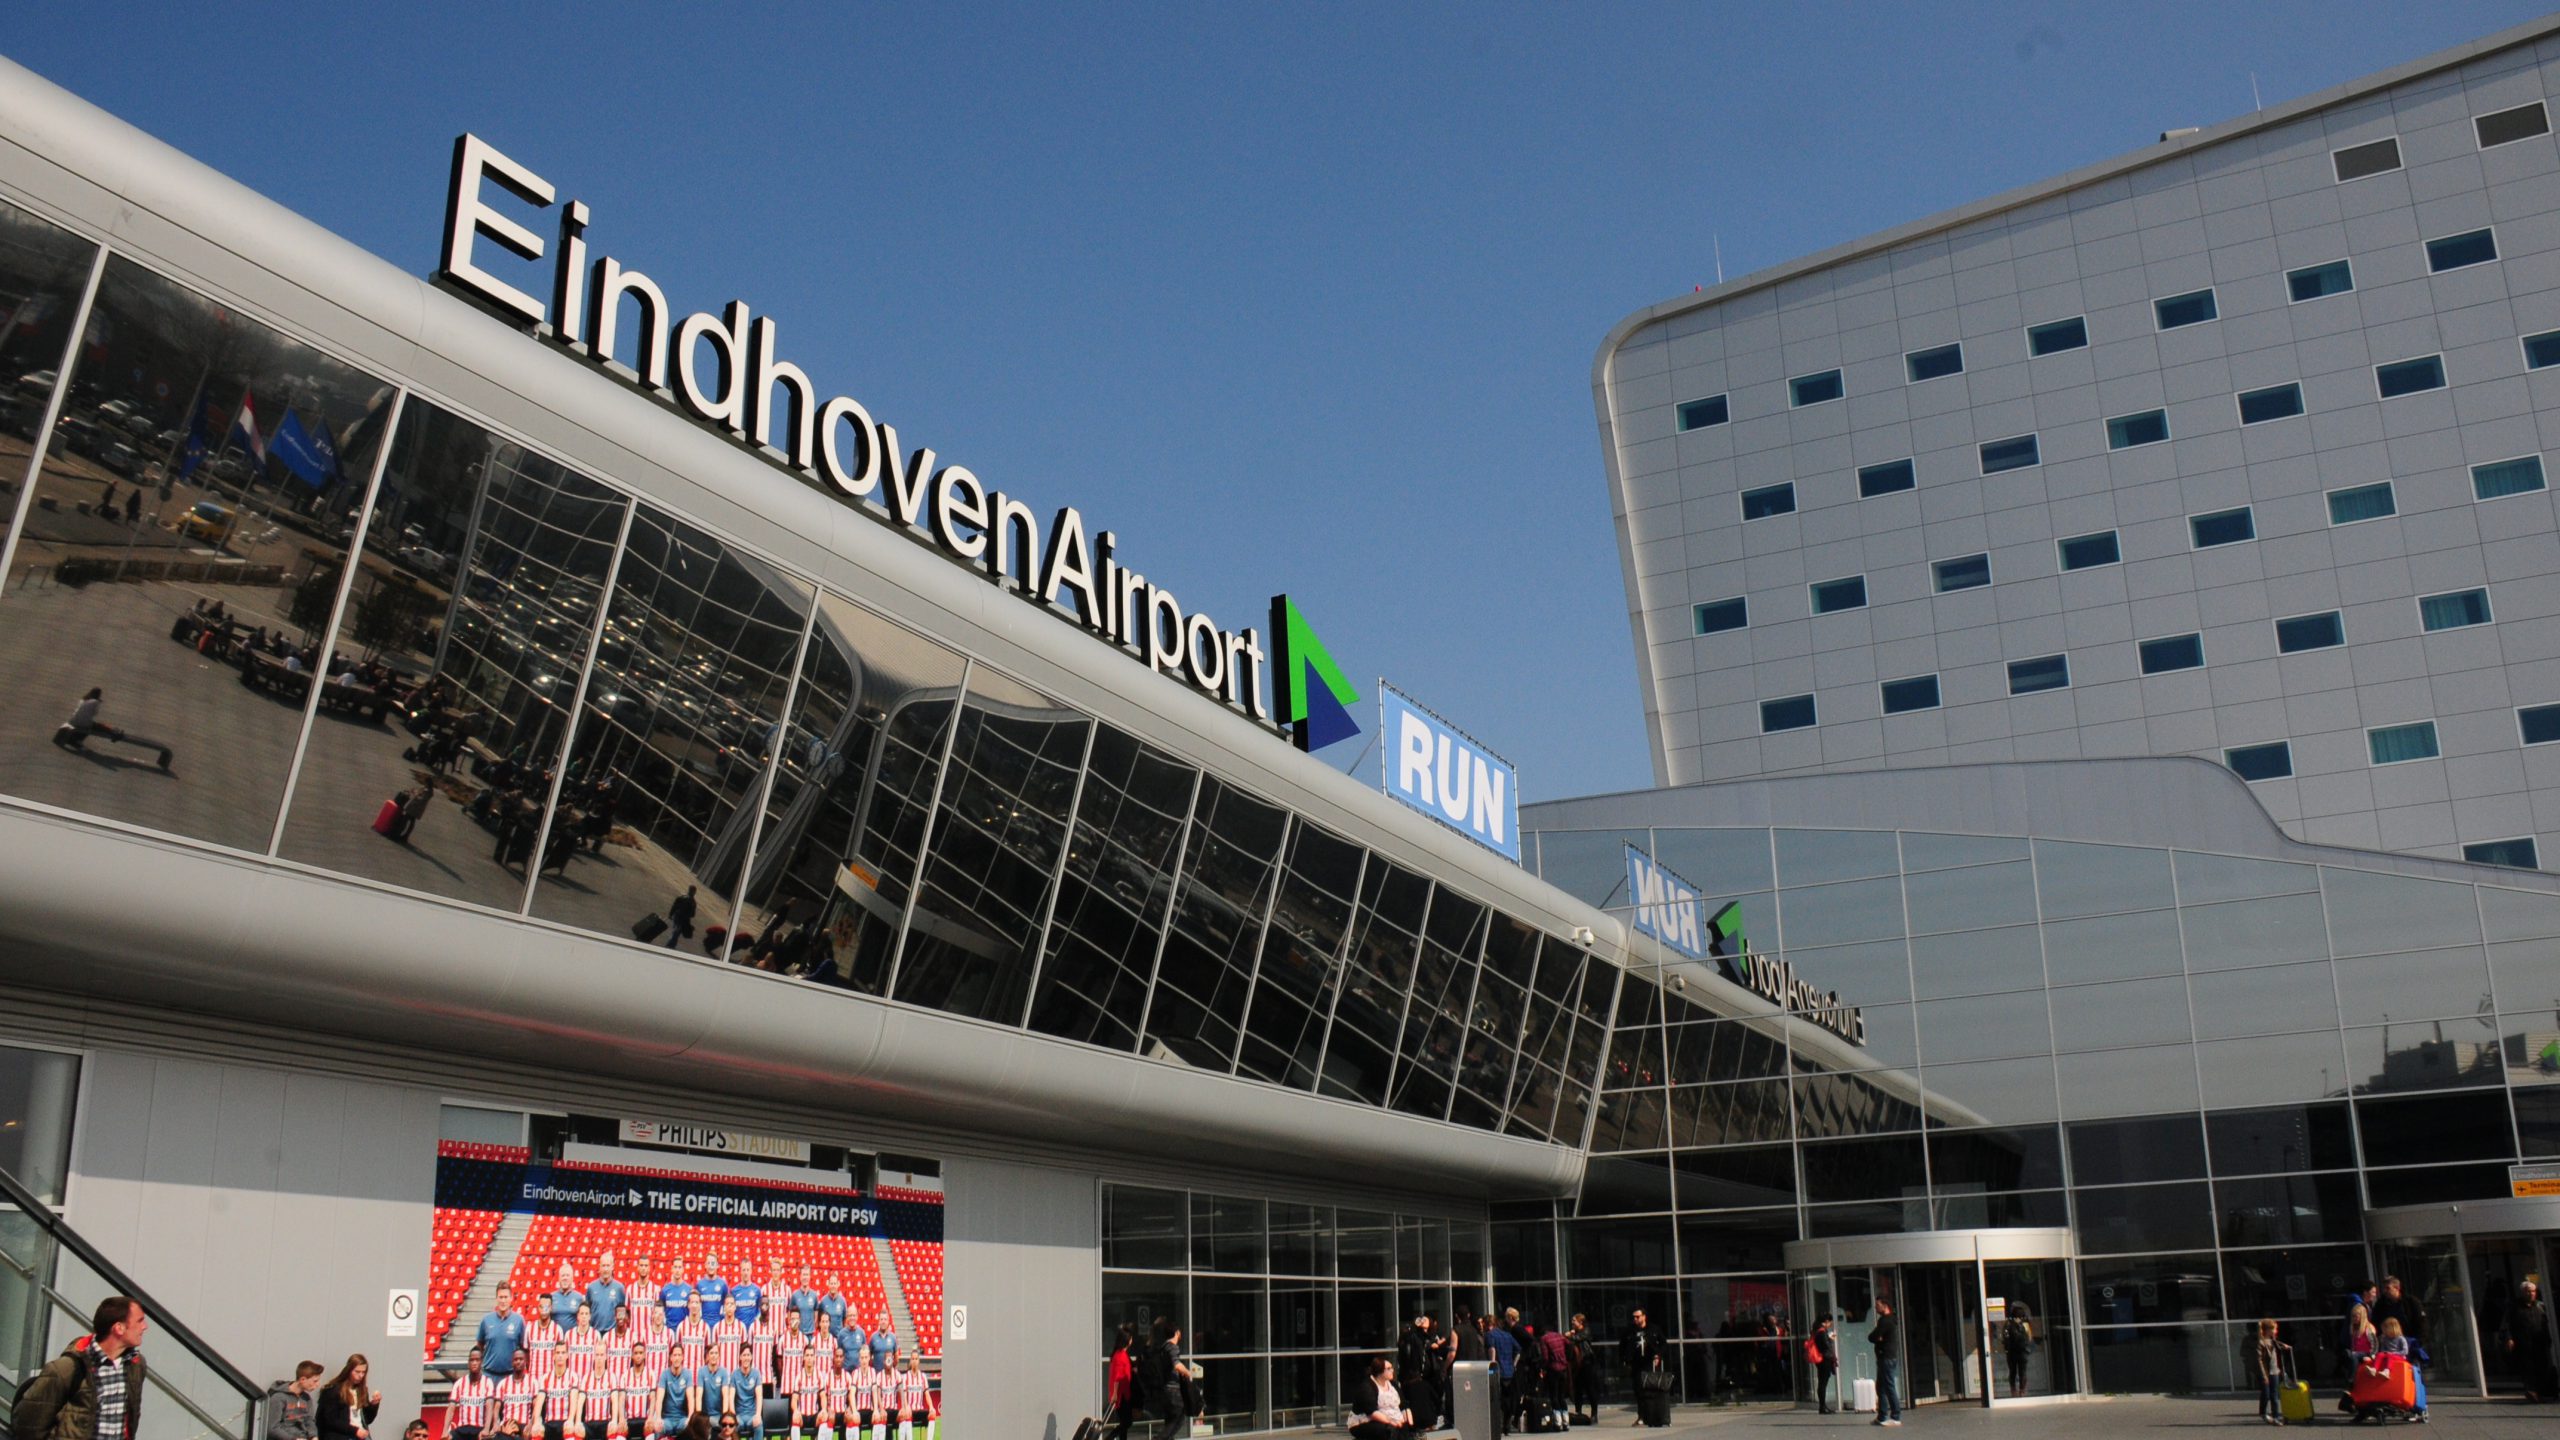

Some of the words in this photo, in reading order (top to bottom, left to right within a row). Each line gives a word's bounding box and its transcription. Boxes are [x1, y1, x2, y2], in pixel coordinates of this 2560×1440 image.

[440, 132, 1267, 720] EindhovenAirport
[1400, 709, 1505, 845] RUN
[658, 1123, 727, 1149] PHILIPS
[522, 1183, 626, 1208] EindhovenAirport
[647, 1190, 682, 1211] THE
[684, 1193, 759, 1217] OFFICIAL
[759, 1200, 827, 1223] AIRPORT
[828, 1206, 849, 1223] OF
[850, 1207, 878, 1226] PSV
